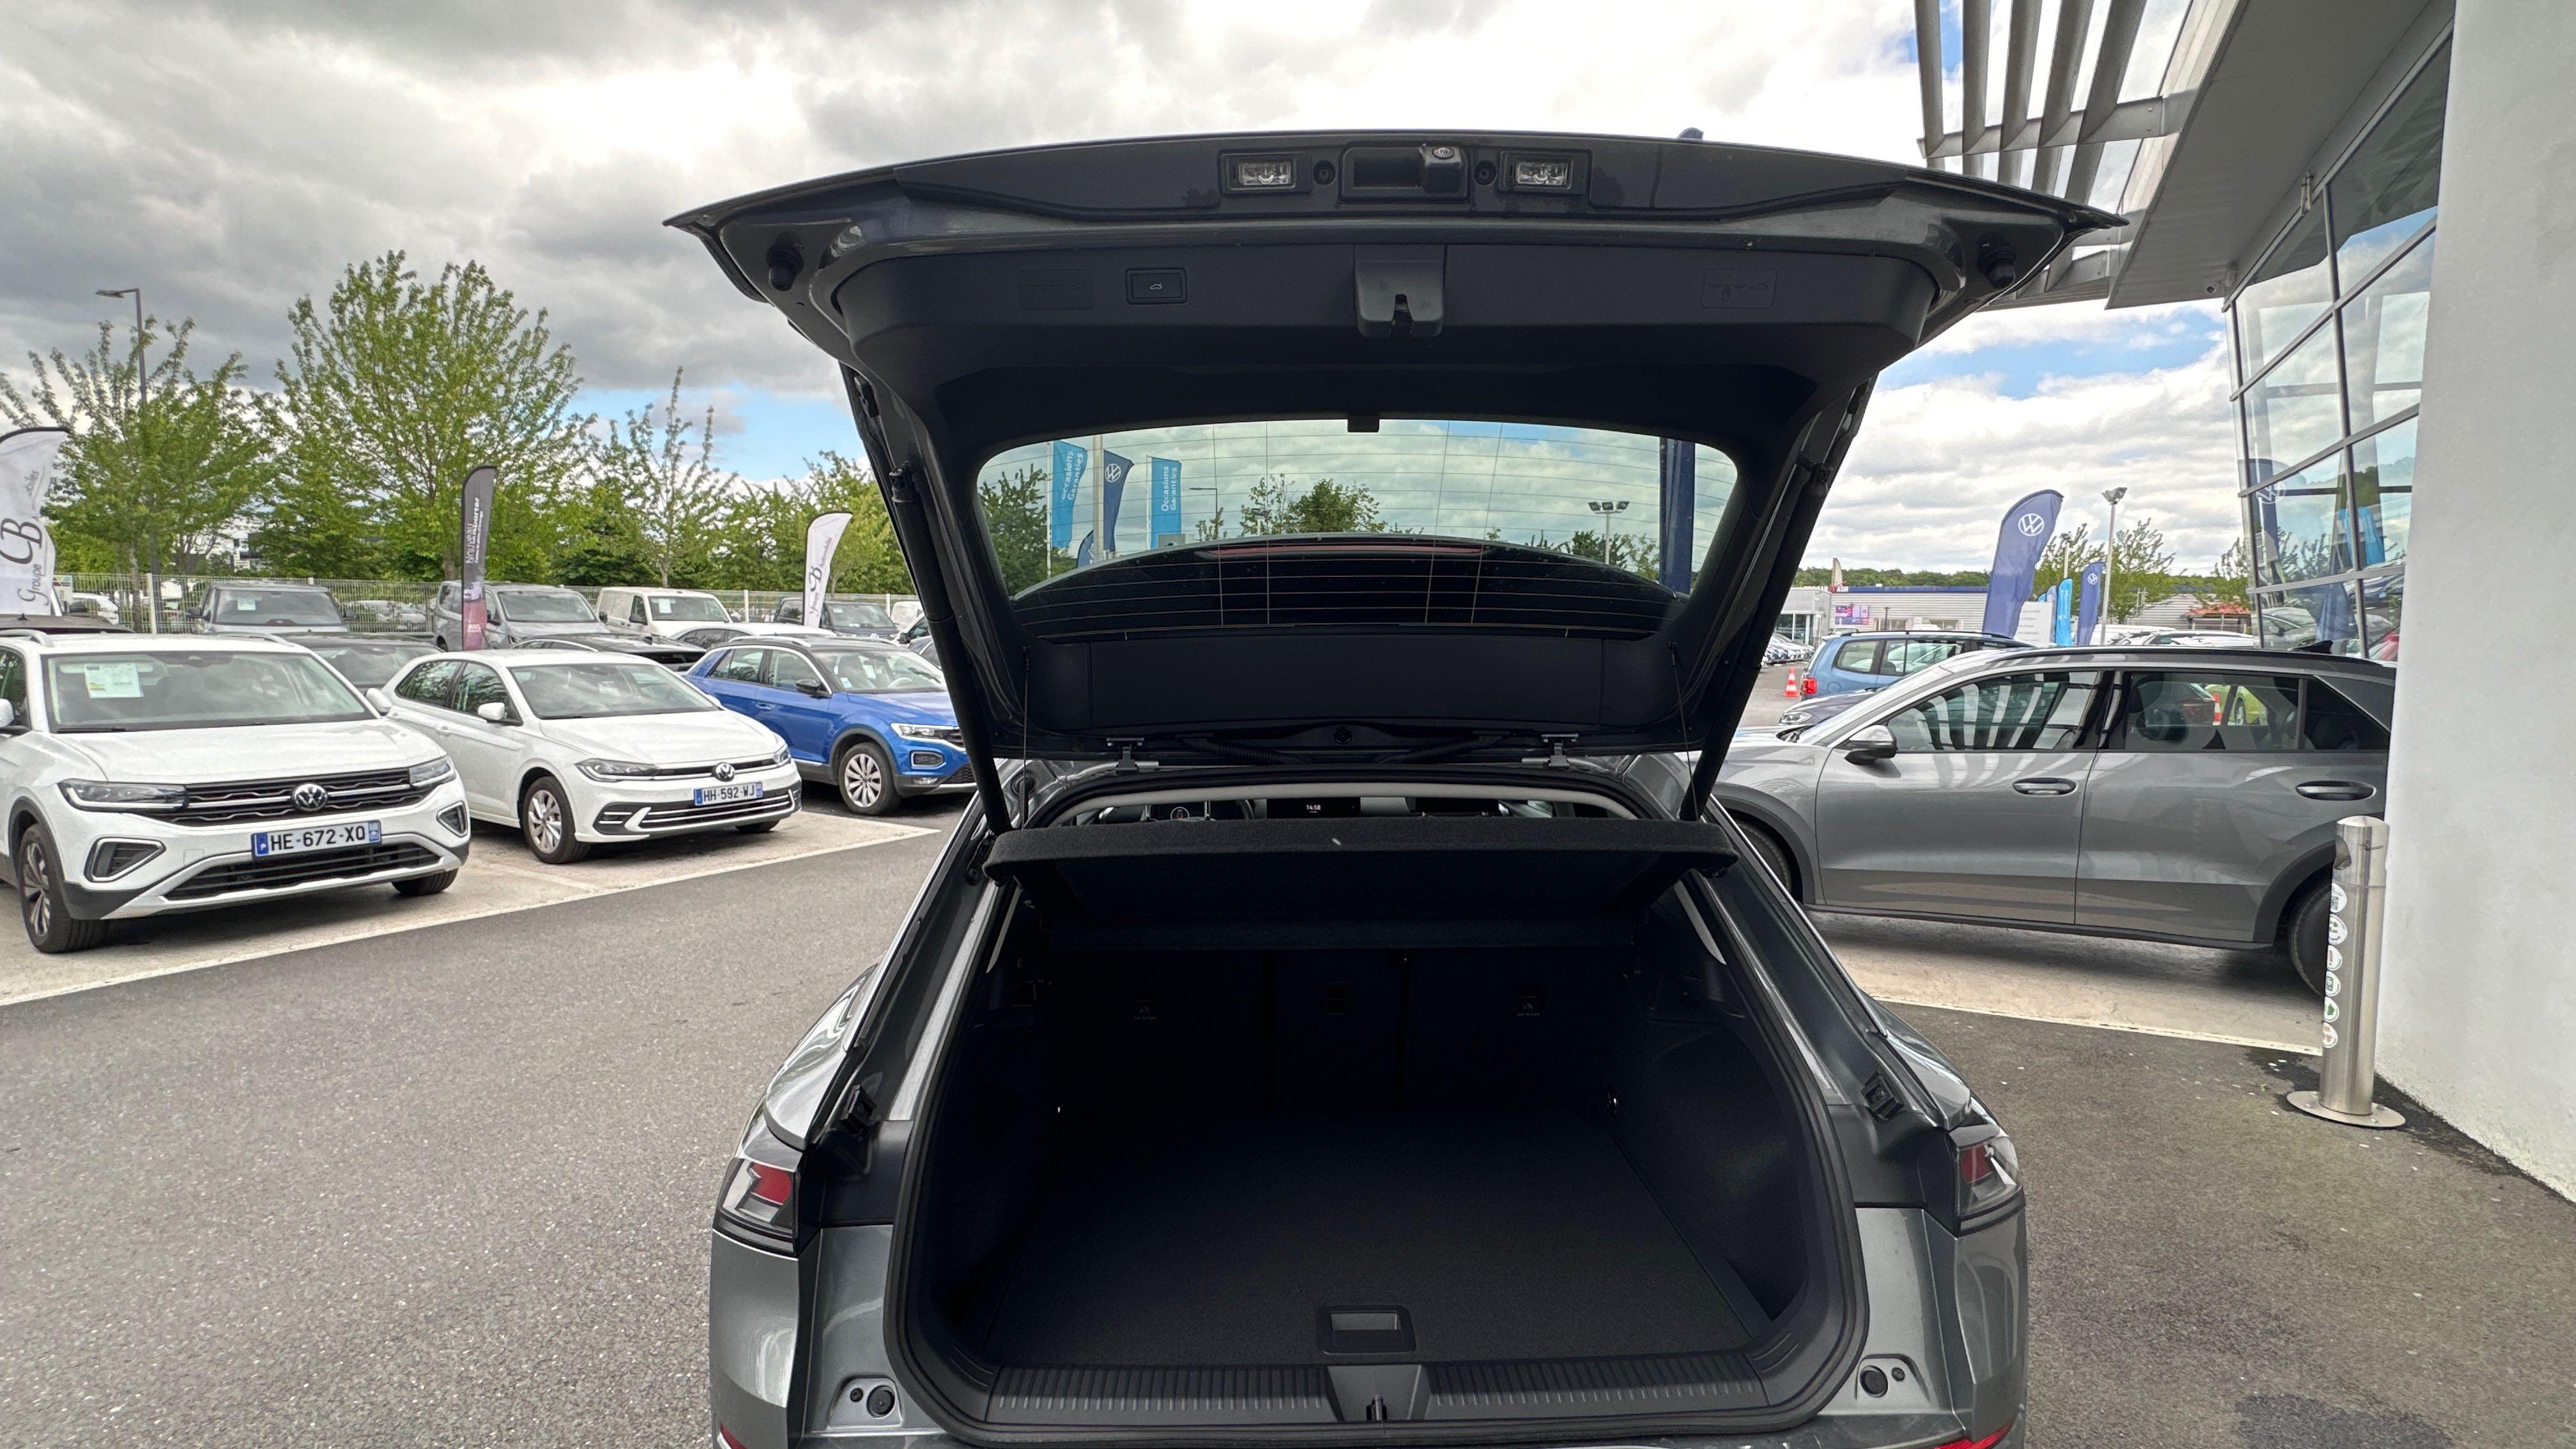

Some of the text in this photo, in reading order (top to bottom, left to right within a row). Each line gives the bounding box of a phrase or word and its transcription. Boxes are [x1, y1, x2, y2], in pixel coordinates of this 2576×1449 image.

[1068, 452, 1084, 500] Garanties
[1161, 466, 1170, 512] Occasions
[465, 523, 475, 564] Nouveau
[17, 564, 49, 606] Groupe
[703, 785, 755, 802] HH-592-WJ
